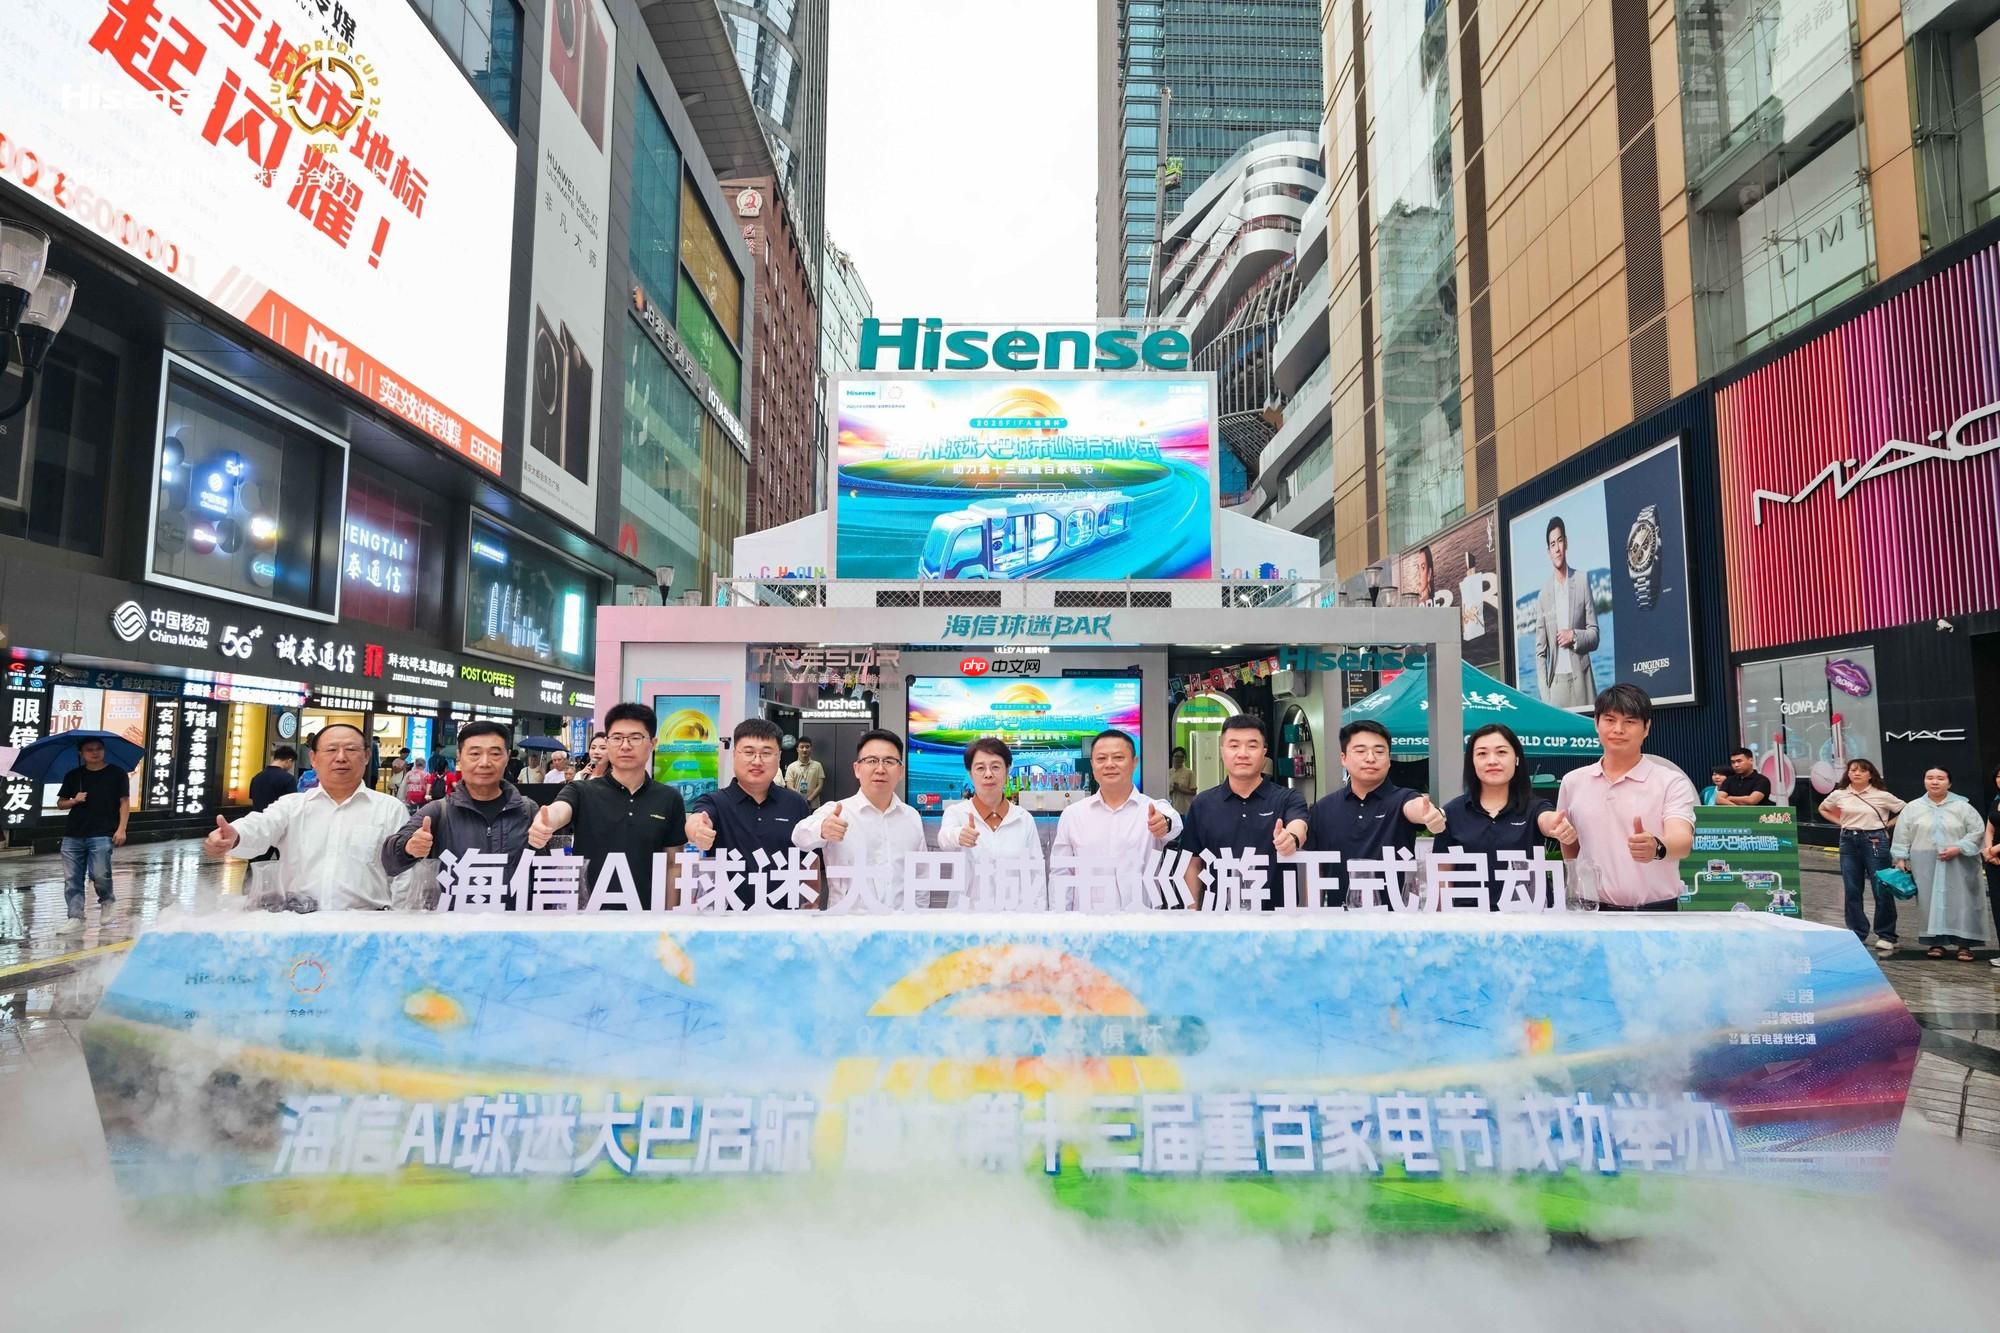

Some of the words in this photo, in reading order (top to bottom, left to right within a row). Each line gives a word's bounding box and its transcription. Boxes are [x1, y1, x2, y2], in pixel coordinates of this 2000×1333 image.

[547, 147, 575, 197] HUAWEI
[858, 317, 1190, 372] Hisense
[150, 607, 211, 637] 中国移动
[940, 613, 1113, 641] 海信球迷BAR
[149, 628, 178, 646] China
[178, 633, 208, 650] Mobile
[1279, 644, 1427, 672] Hisense
[1633, 657, 1670, 673] LONGINES
[461, 666, 481, 681] POST
[481, 670, 508, 686] COFFEE
[58, 699, 84, 712] 黄金
[1780, 699, 1829, 716] GLOWPLAY
[4, 698, 41, 811] 眼镜发
[151, 708, 174, 796] 名表维修中心
[1391, 735, 1430, 746] sense
[1543, 735, 1568, 747] CUP
[1570, 736, 1600, 748] 2025
[185, 727, 208, 814] 名表维修中心
[7, 814, 25, 824] 3F
[438, 845, 1566, 912] 海信AI球迷大巴城市巡游正式启动
[275, 1091, 815, 1175] 海信AI球迷大巴启航
